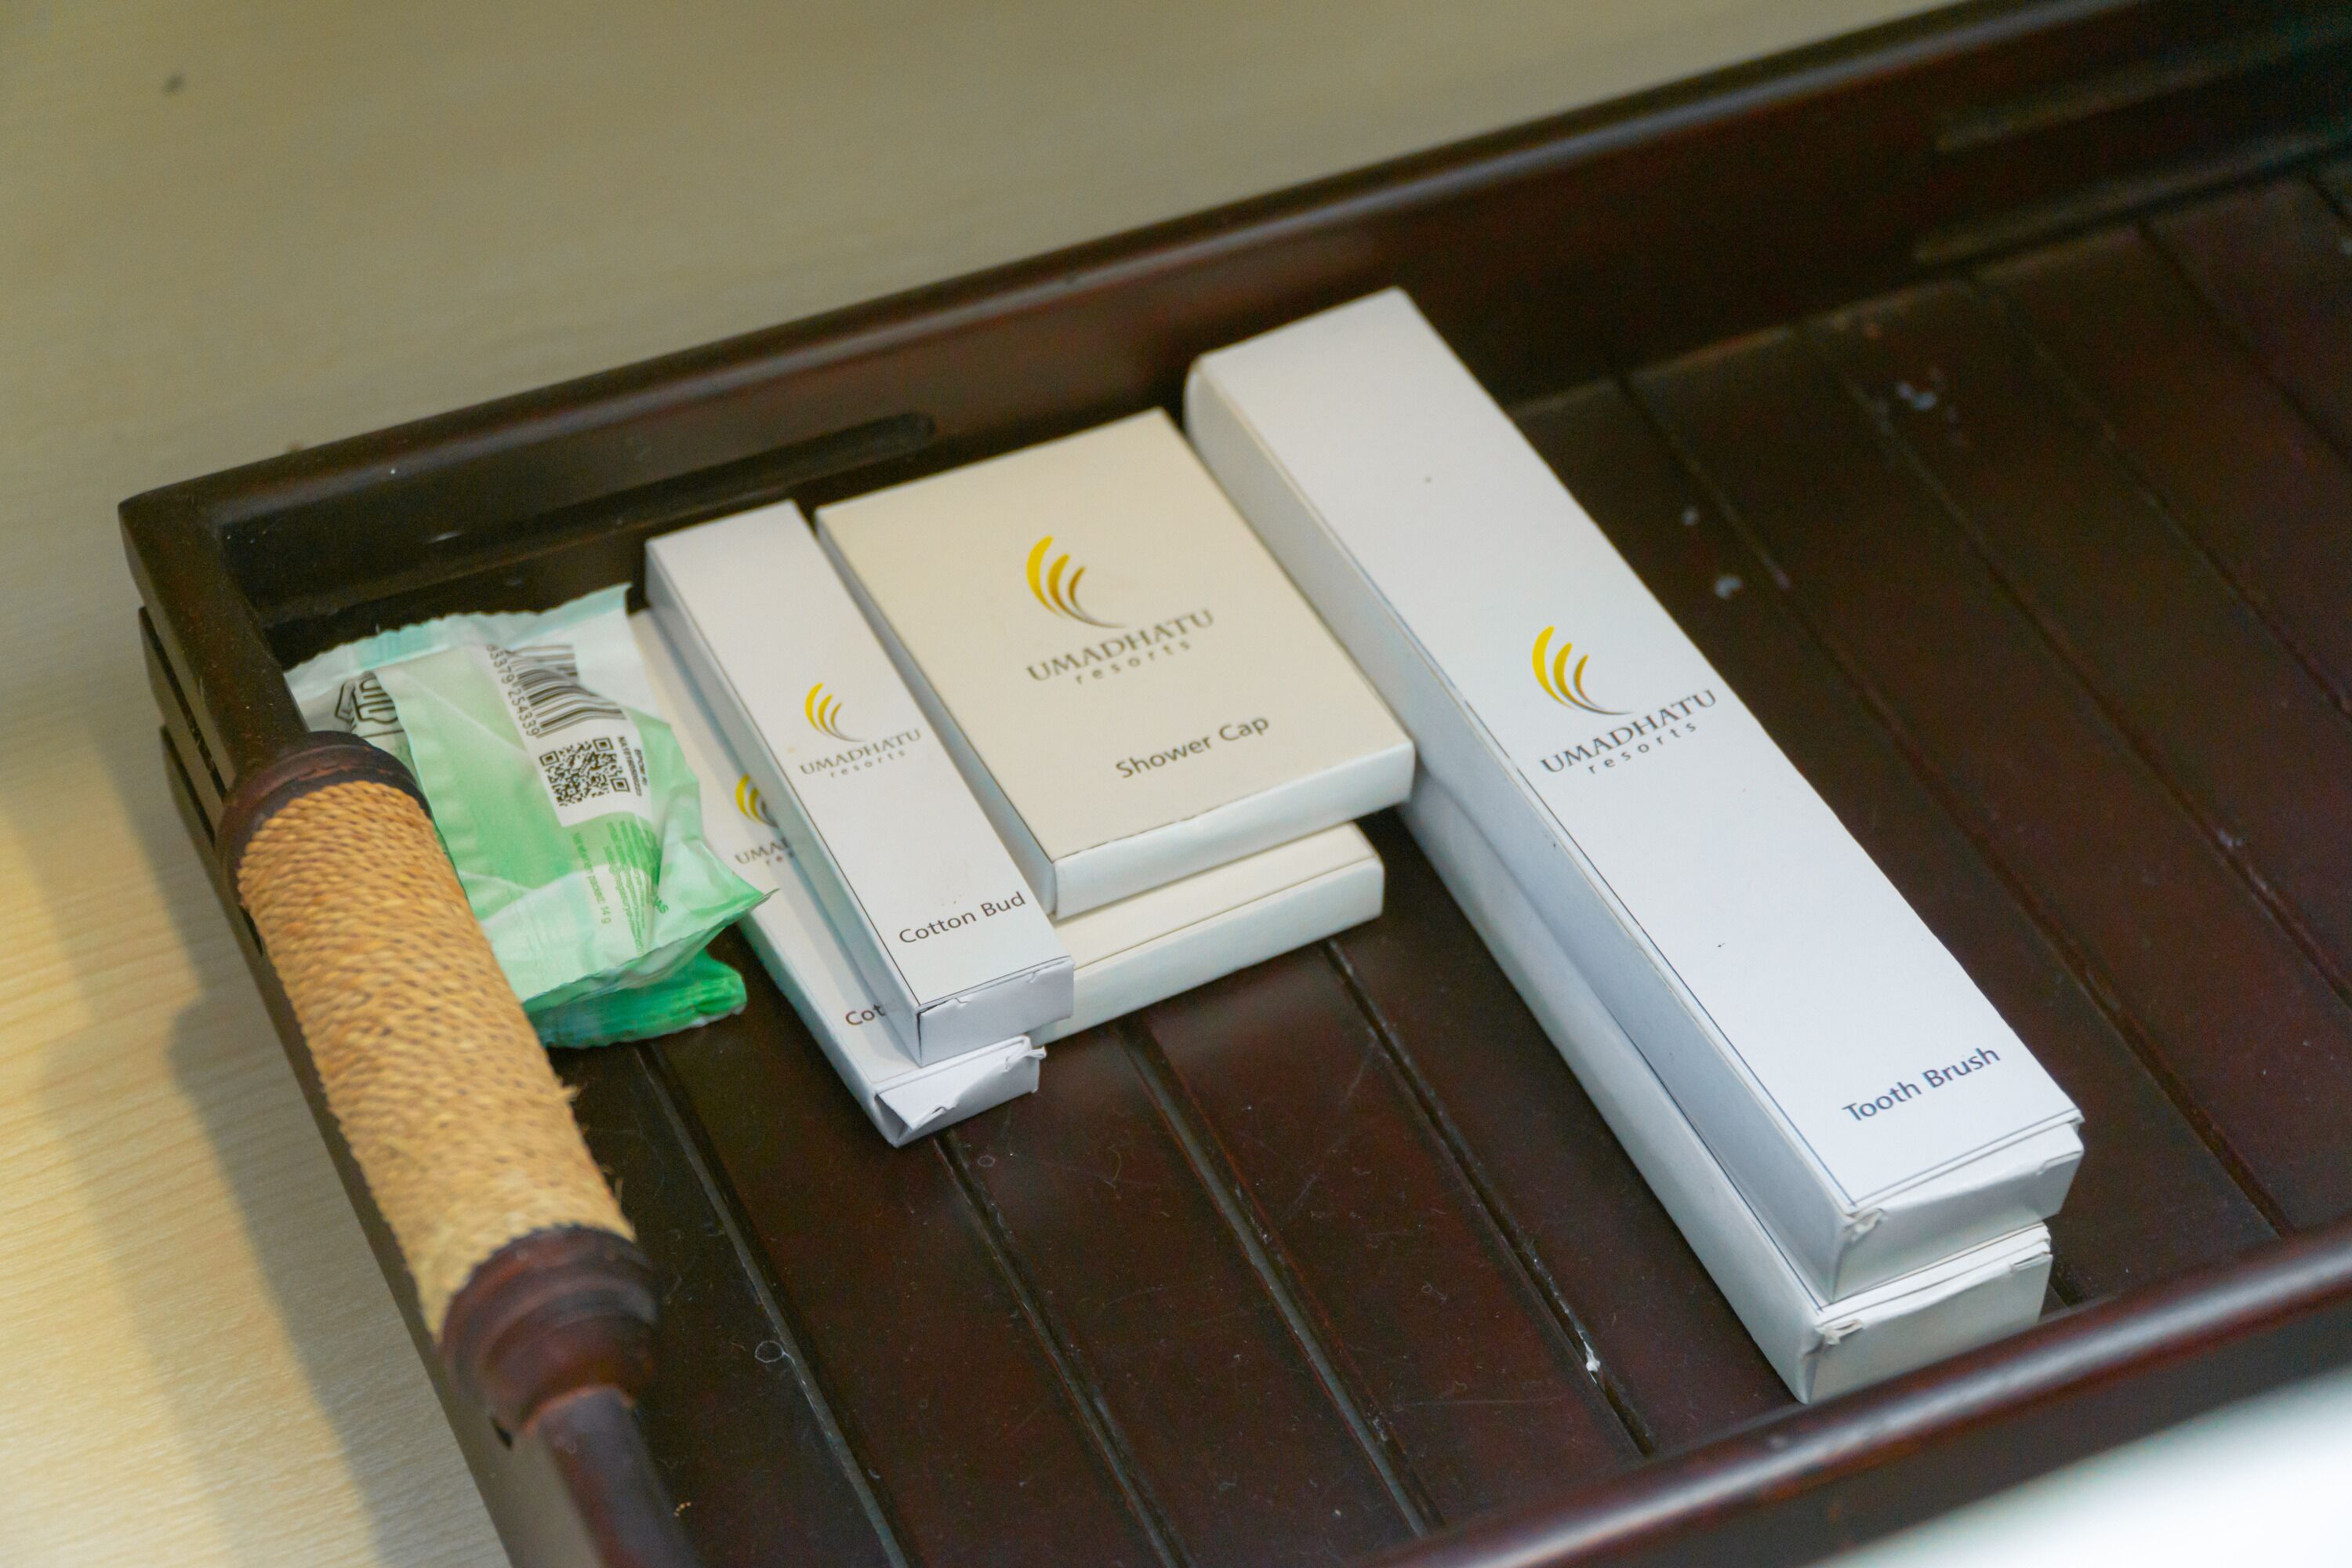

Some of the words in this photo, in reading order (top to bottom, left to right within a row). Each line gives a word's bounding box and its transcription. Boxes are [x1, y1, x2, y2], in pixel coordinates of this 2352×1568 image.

[1026, 608, 1214, 681] UMADHATU
[1075, 639, 1192, 685] resorts
[507, 688, 540, 736] 254339
[1539, 689, 1717, 773] UMADHATU
[798, 728, 924, 775] UMADHATU
[829, 750, 907, 779] resorts
[1115, 734, 1212, 779] Shower
[1218, 716, 1270, 743] Cap
[1588, 722, 1697, 775] resorts
[898, 907, 978, 945] Cotton
[982, 891, 1027, 918] Bud
[845, 1004, 886, 1025] Cot
[1840, 1081, 1923, 1122] Tooth
[1921, 1047, 2002, 1089] Brush
